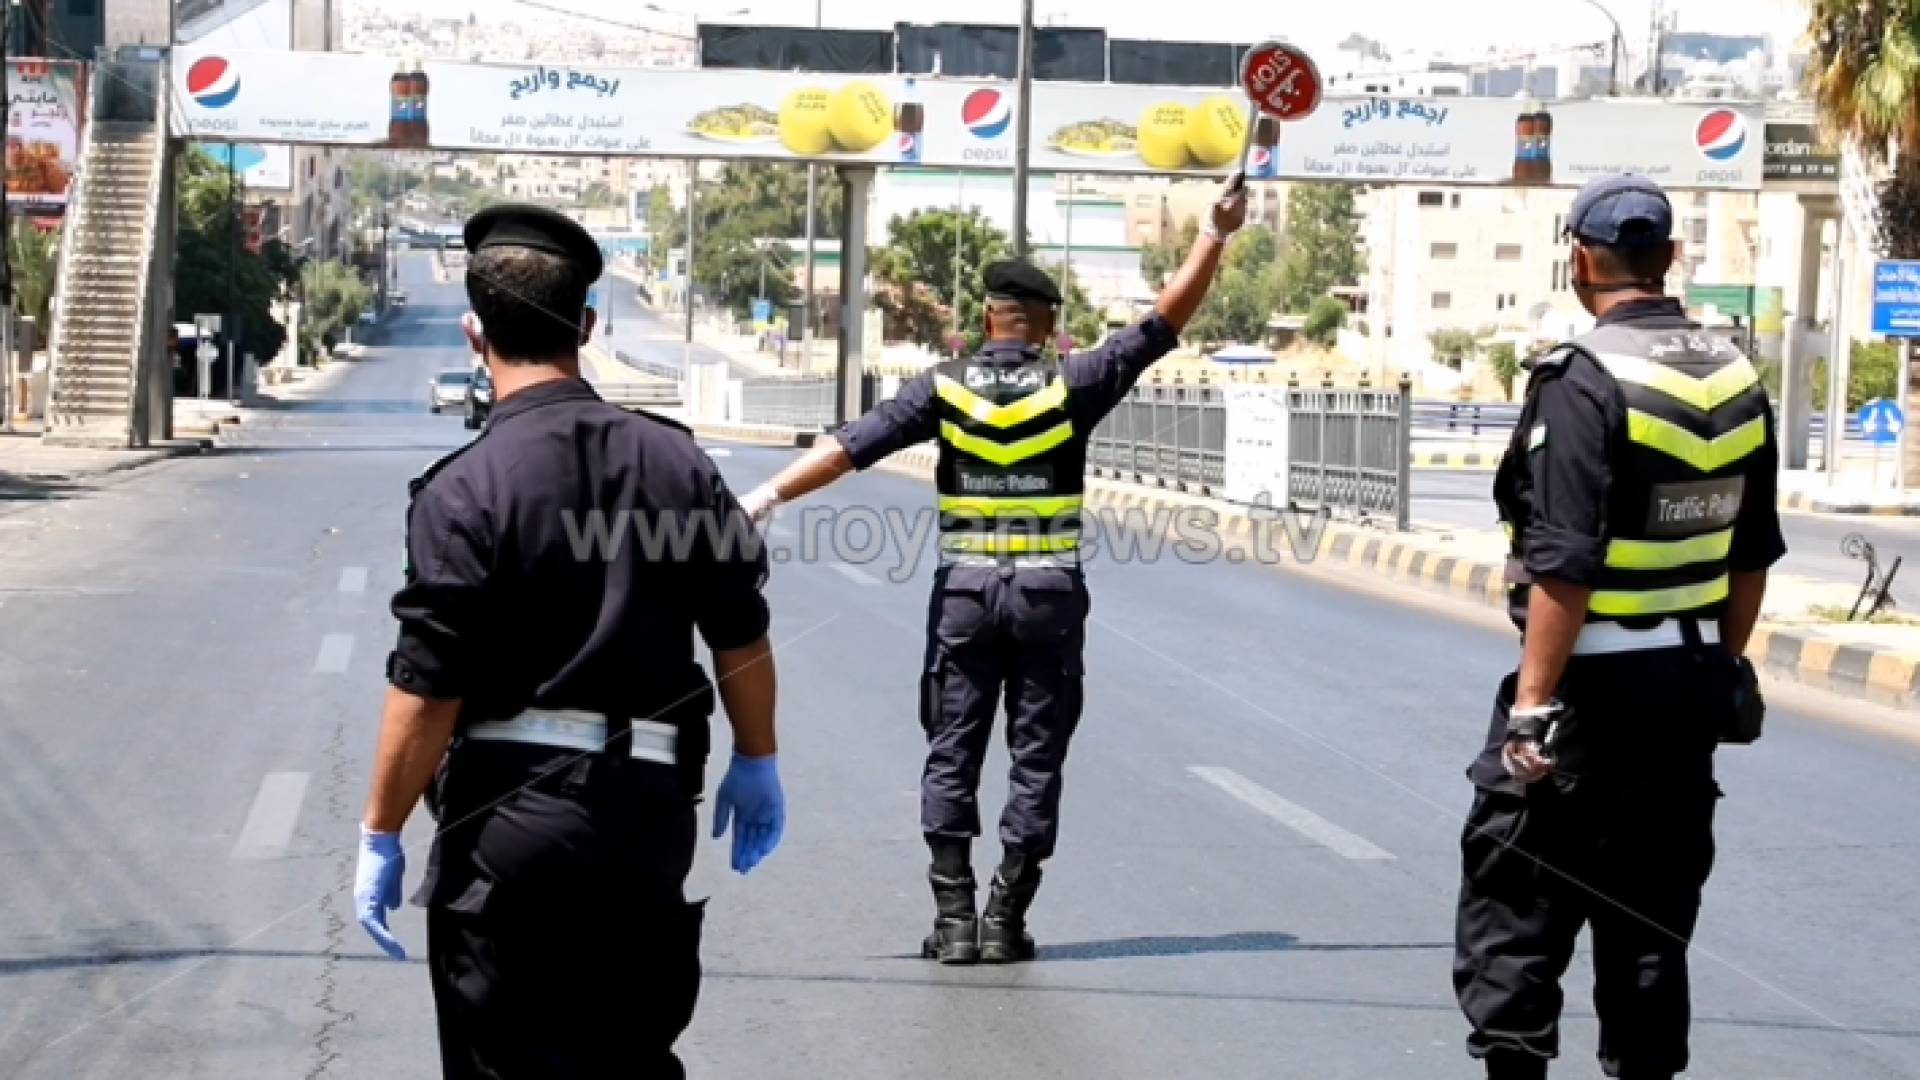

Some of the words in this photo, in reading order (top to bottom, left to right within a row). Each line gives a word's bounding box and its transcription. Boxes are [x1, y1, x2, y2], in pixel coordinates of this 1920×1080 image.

[1251, 49, 1291, 92] STOP
[963, 146, 1008, 162] pepsi
[1697, 168, 1742, 183] pepsi
[960, 472, 1005, 492] Traffic
[1658, 496, 1704, 521] Traffic
